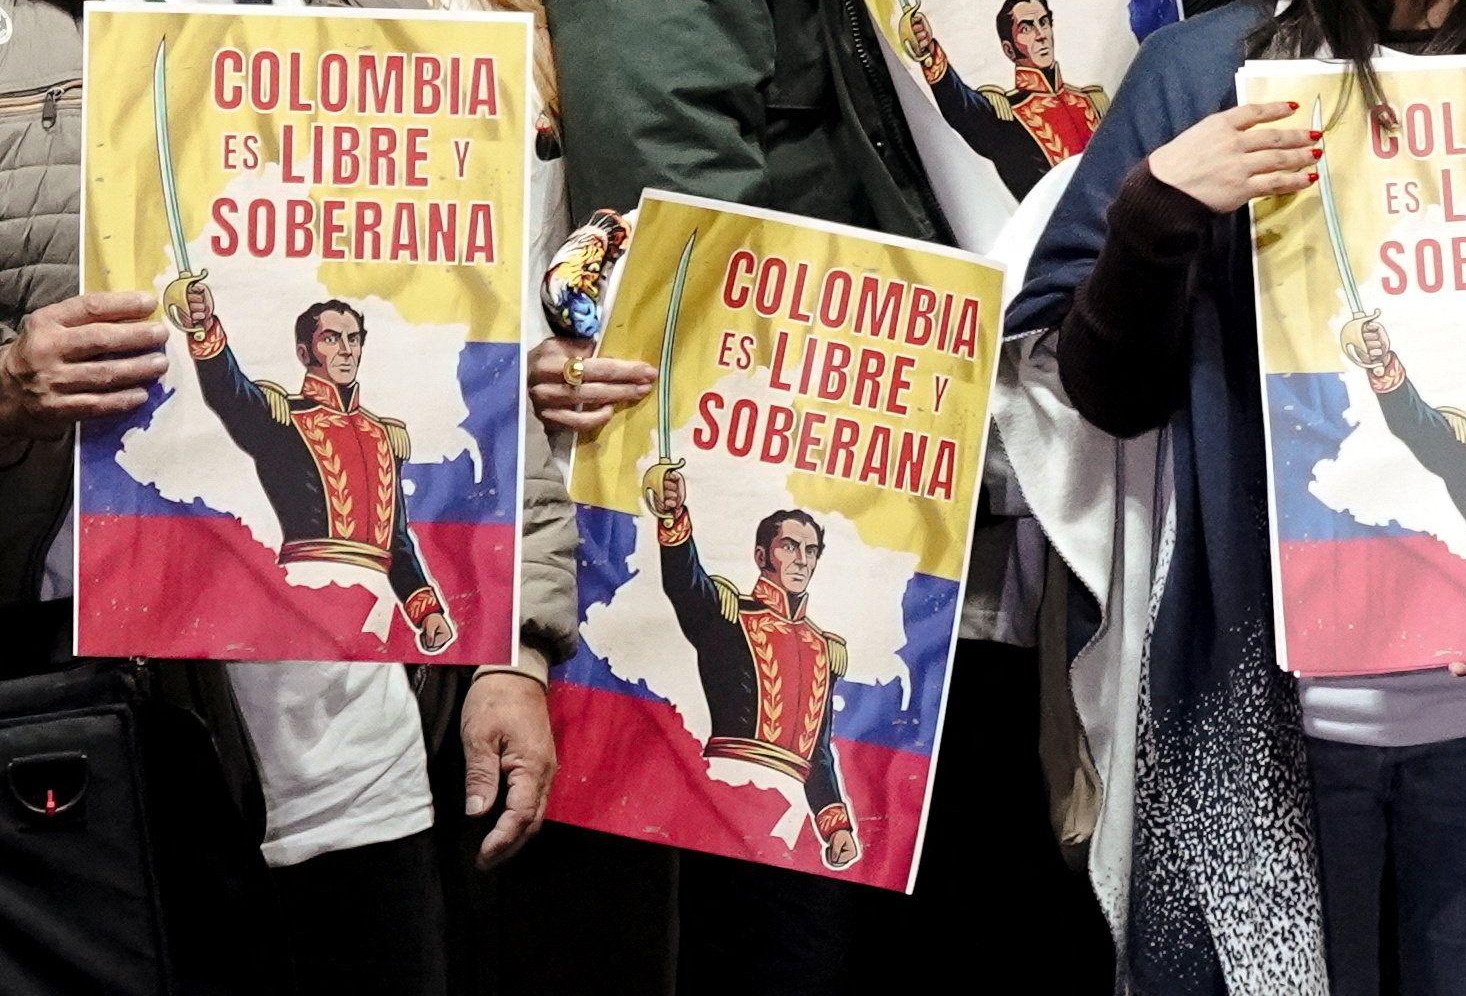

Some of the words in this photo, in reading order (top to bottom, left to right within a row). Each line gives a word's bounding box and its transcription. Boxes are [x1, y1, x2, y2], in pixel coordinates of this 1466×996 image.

[214, 50, 497, 116] COLOMBIA
[223, 134, 259, 169] ES
[282, 125, 429, 186] LIBRE
[454, 141, 470, 177] Y
[211, 197, 494, 262] SOBERANA
[1385, 181, 1420, 214] ES
[723, 250, 979, 358] COLOMBIA
[718, 332, 754, 370] ES
[769, 332, 915, 415] LIBRE
[934, 376, 949, 412] Y
[693, 392, 956, 500] SOBERANA
